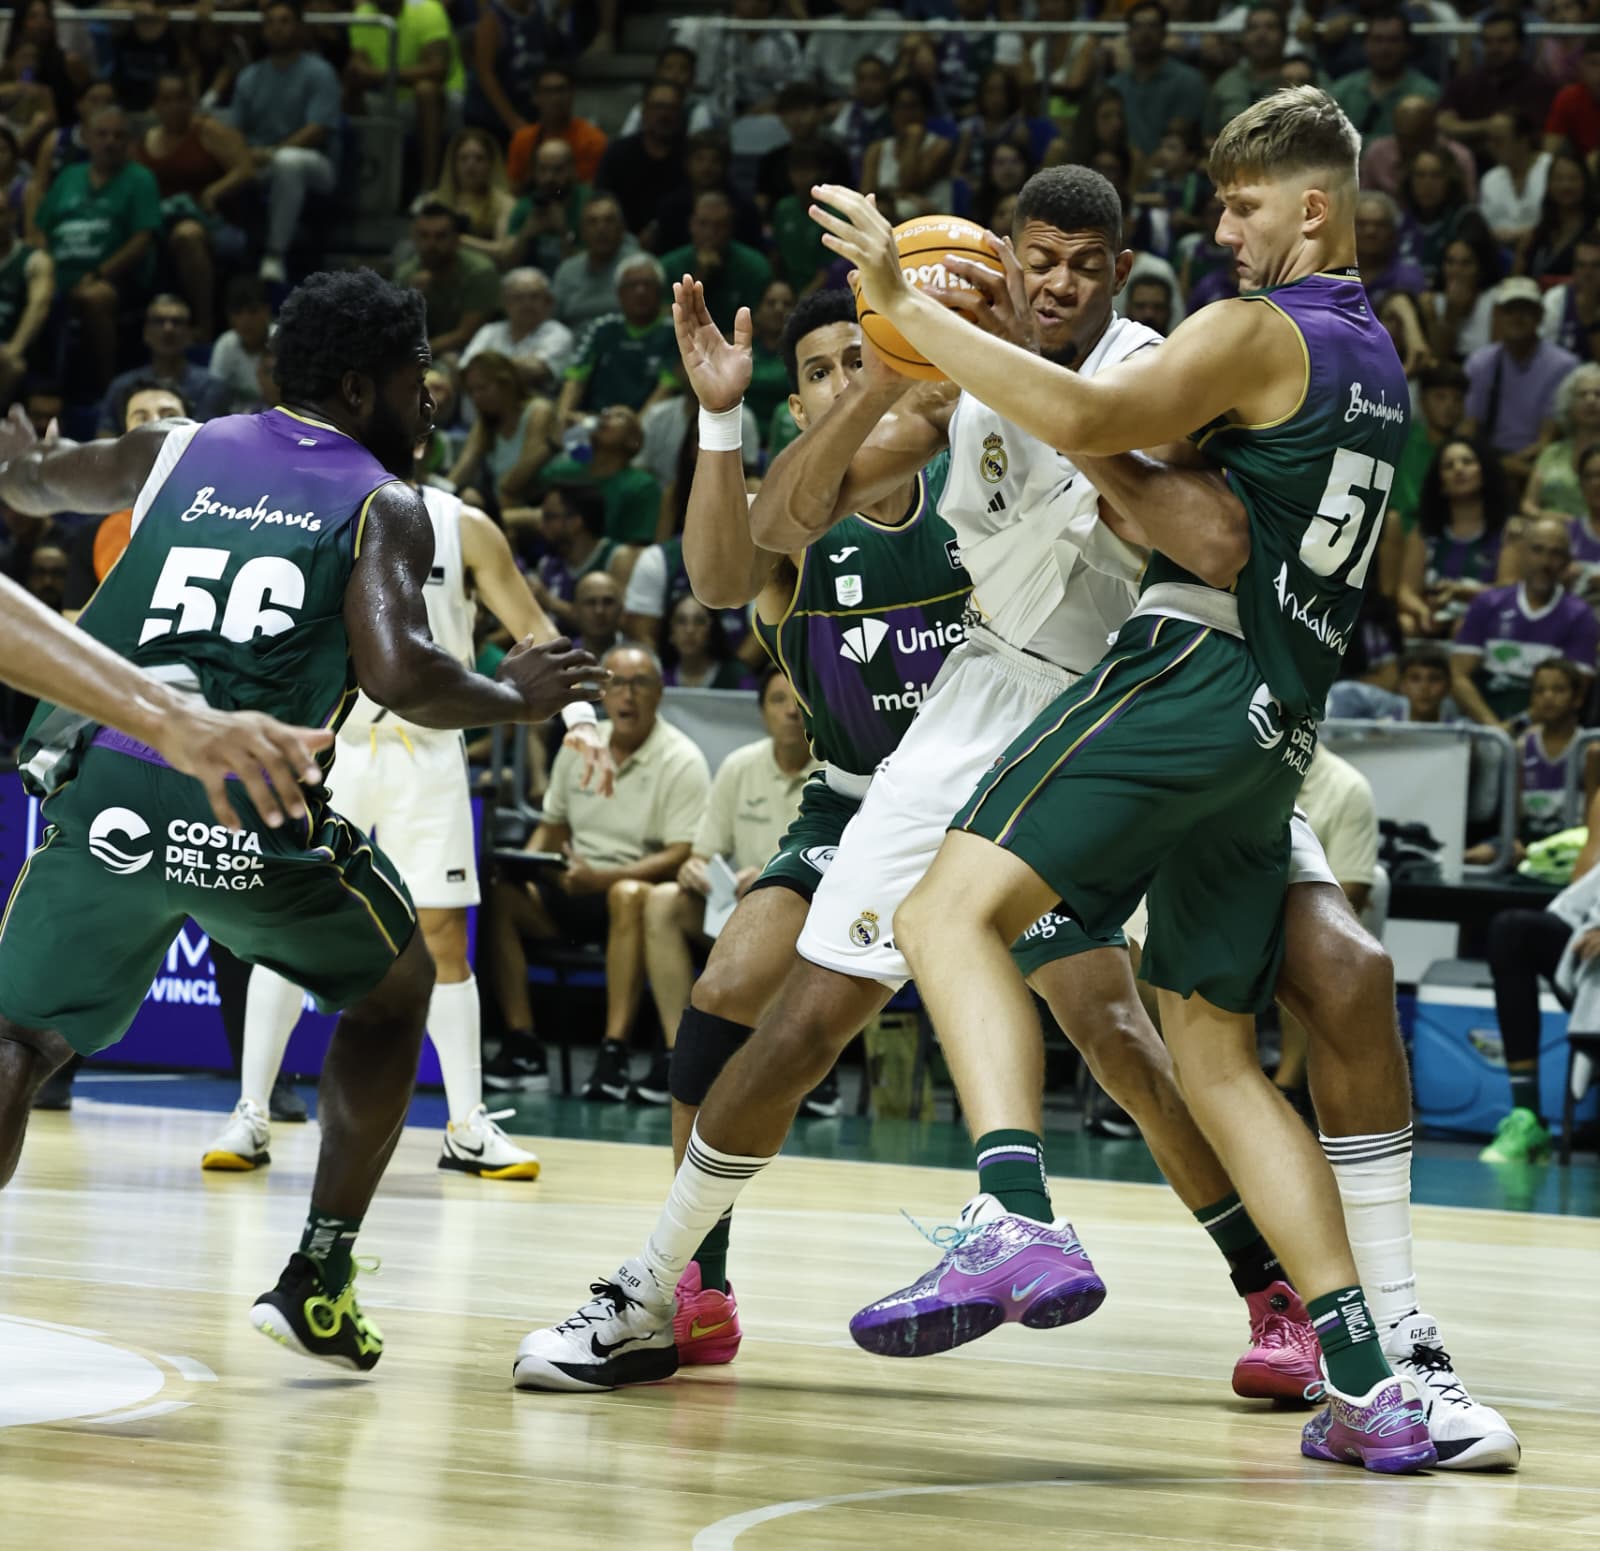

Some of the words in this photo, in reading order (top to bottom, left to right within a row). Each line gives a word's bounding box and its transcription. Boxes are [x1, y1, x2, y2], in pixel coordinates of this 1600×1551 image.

[1298, 447, 1396, 590] 57
[138, 546, 306, 647] 56
[1281, 746, 1309, 776] MÁL
[167, 819, 264, 855] COSTA
[166, 845, 211, 869] DEL
[216, 853, 264, 872] SOL
[165, 866, 264, 890] MÁLAGA
